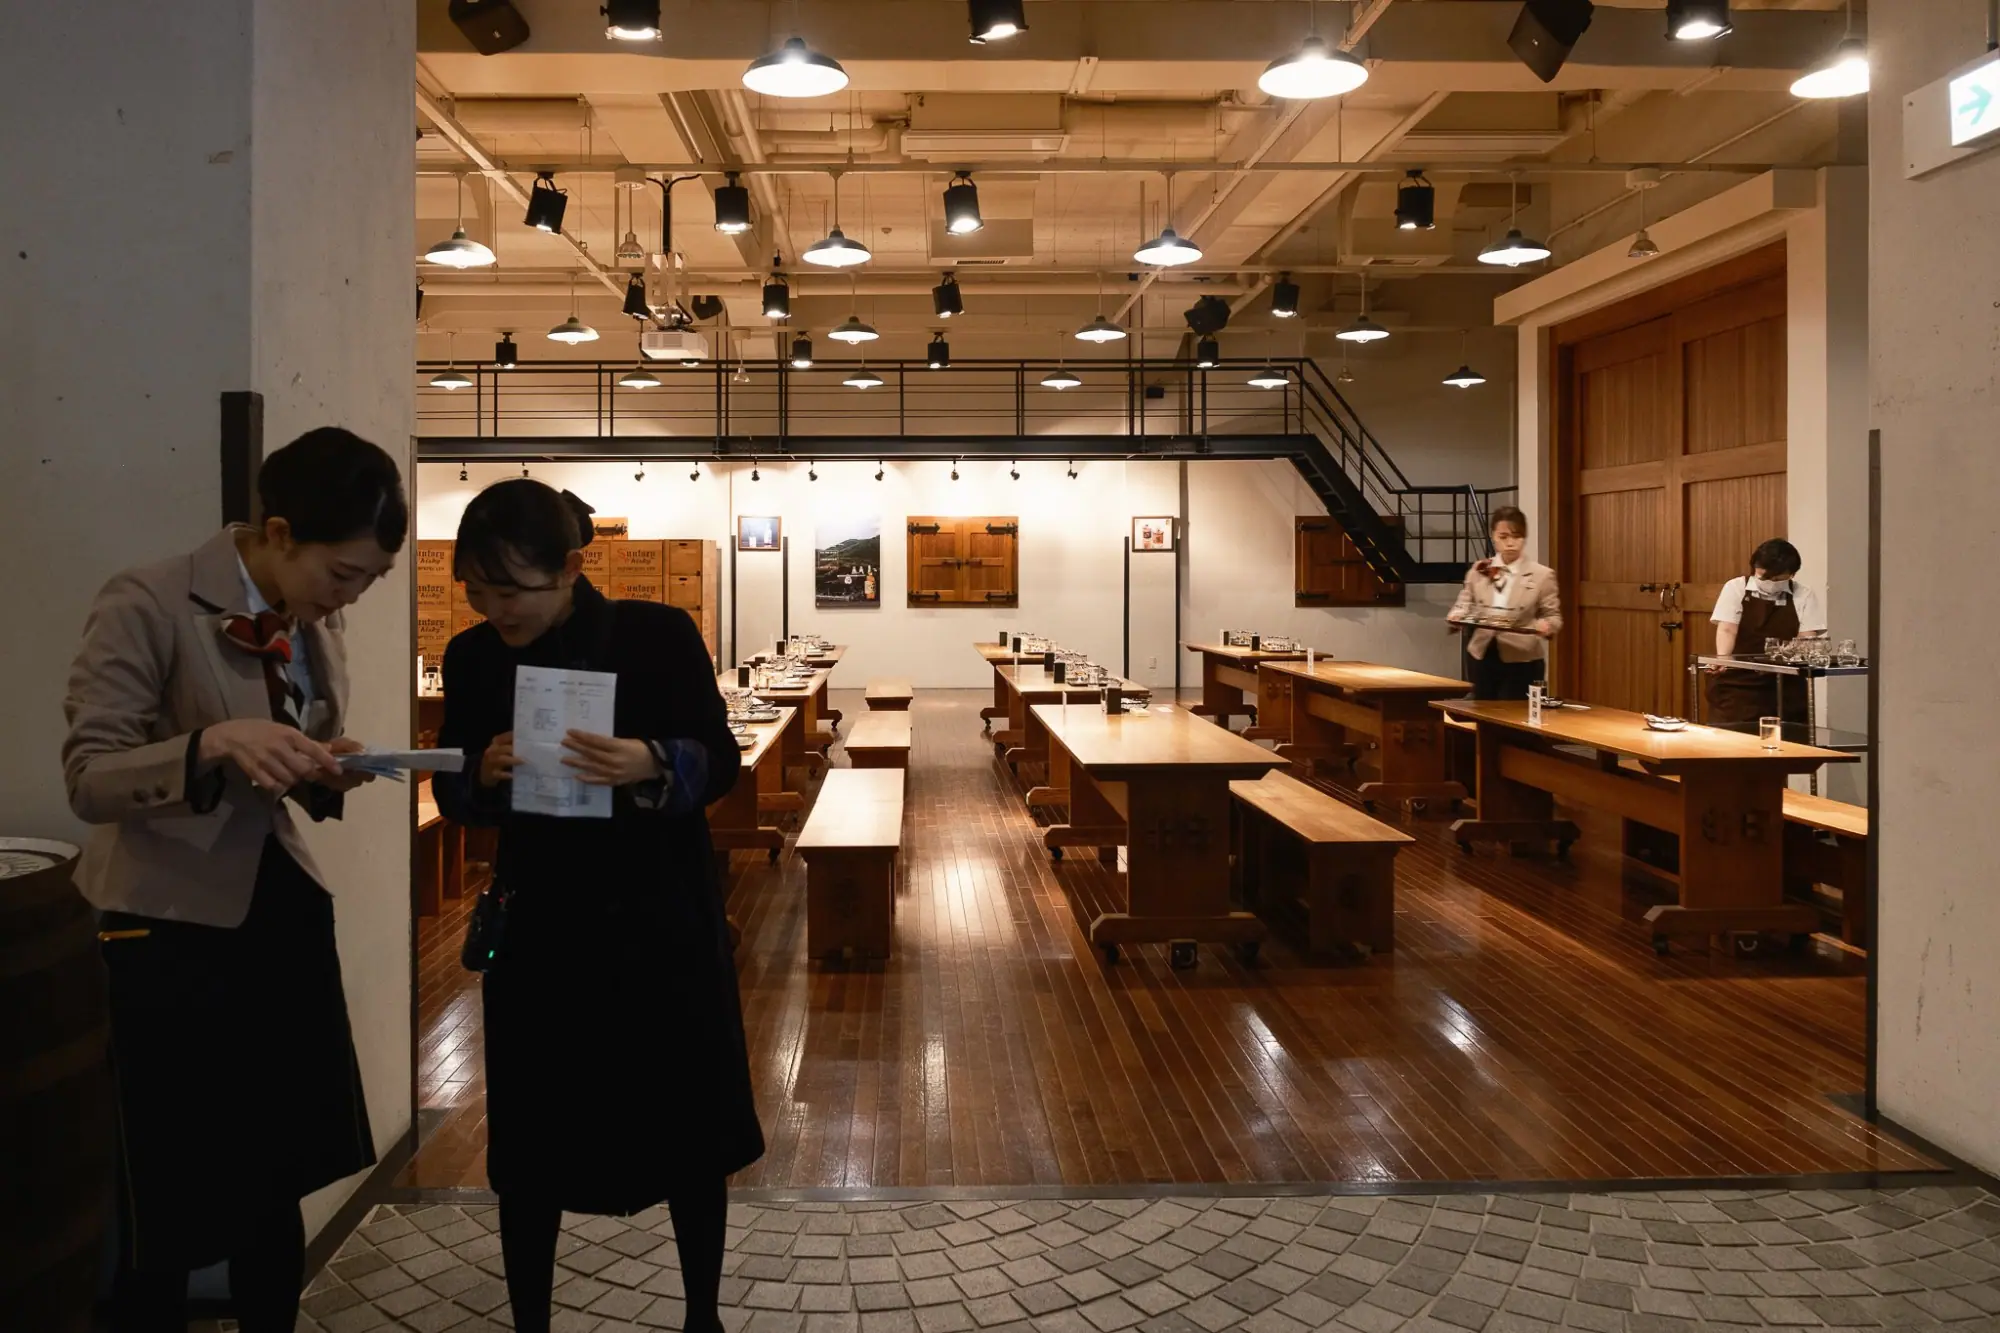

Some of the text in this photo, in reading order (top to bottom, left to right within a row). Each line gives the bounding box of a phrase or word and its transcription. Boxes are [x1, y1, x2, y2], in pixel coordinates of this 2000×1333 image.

[416, 550, 445, 560] untory
[617, 548, 656, 560] Suntory
[416, 584, 445, 594] untory
[617, 582, 656, 594] Suntory
[418, 618, 445, 628] untory
